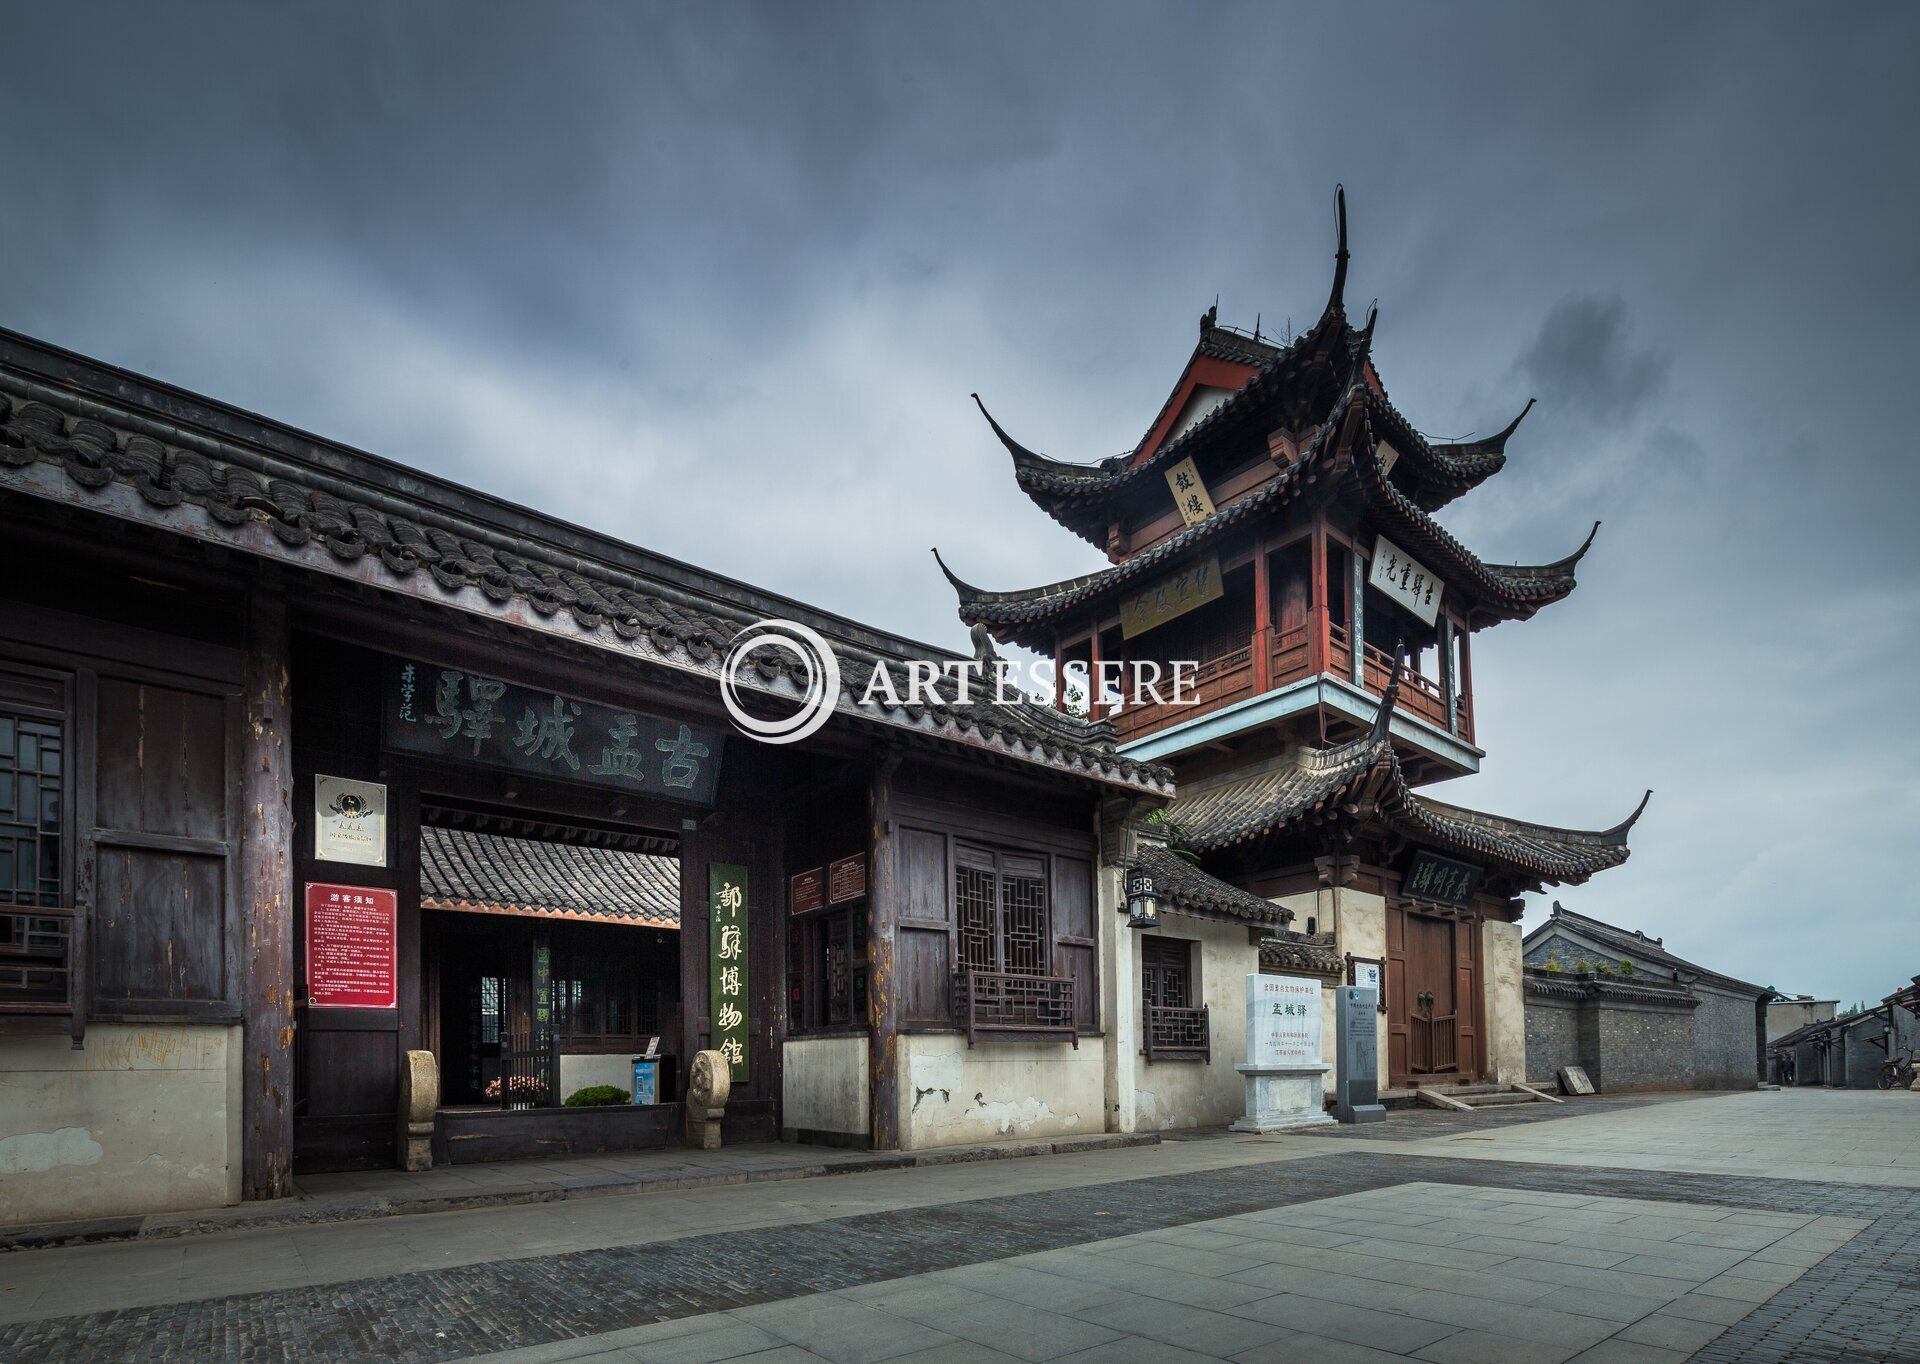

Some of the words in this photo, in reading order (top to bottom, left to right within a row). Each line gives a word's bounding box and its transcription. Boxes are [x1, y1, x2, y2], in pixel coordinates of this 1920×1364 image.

[330, 893, 374, 905] 游客须知
[1272, 1003, 1307, 1016] 盂城驿
